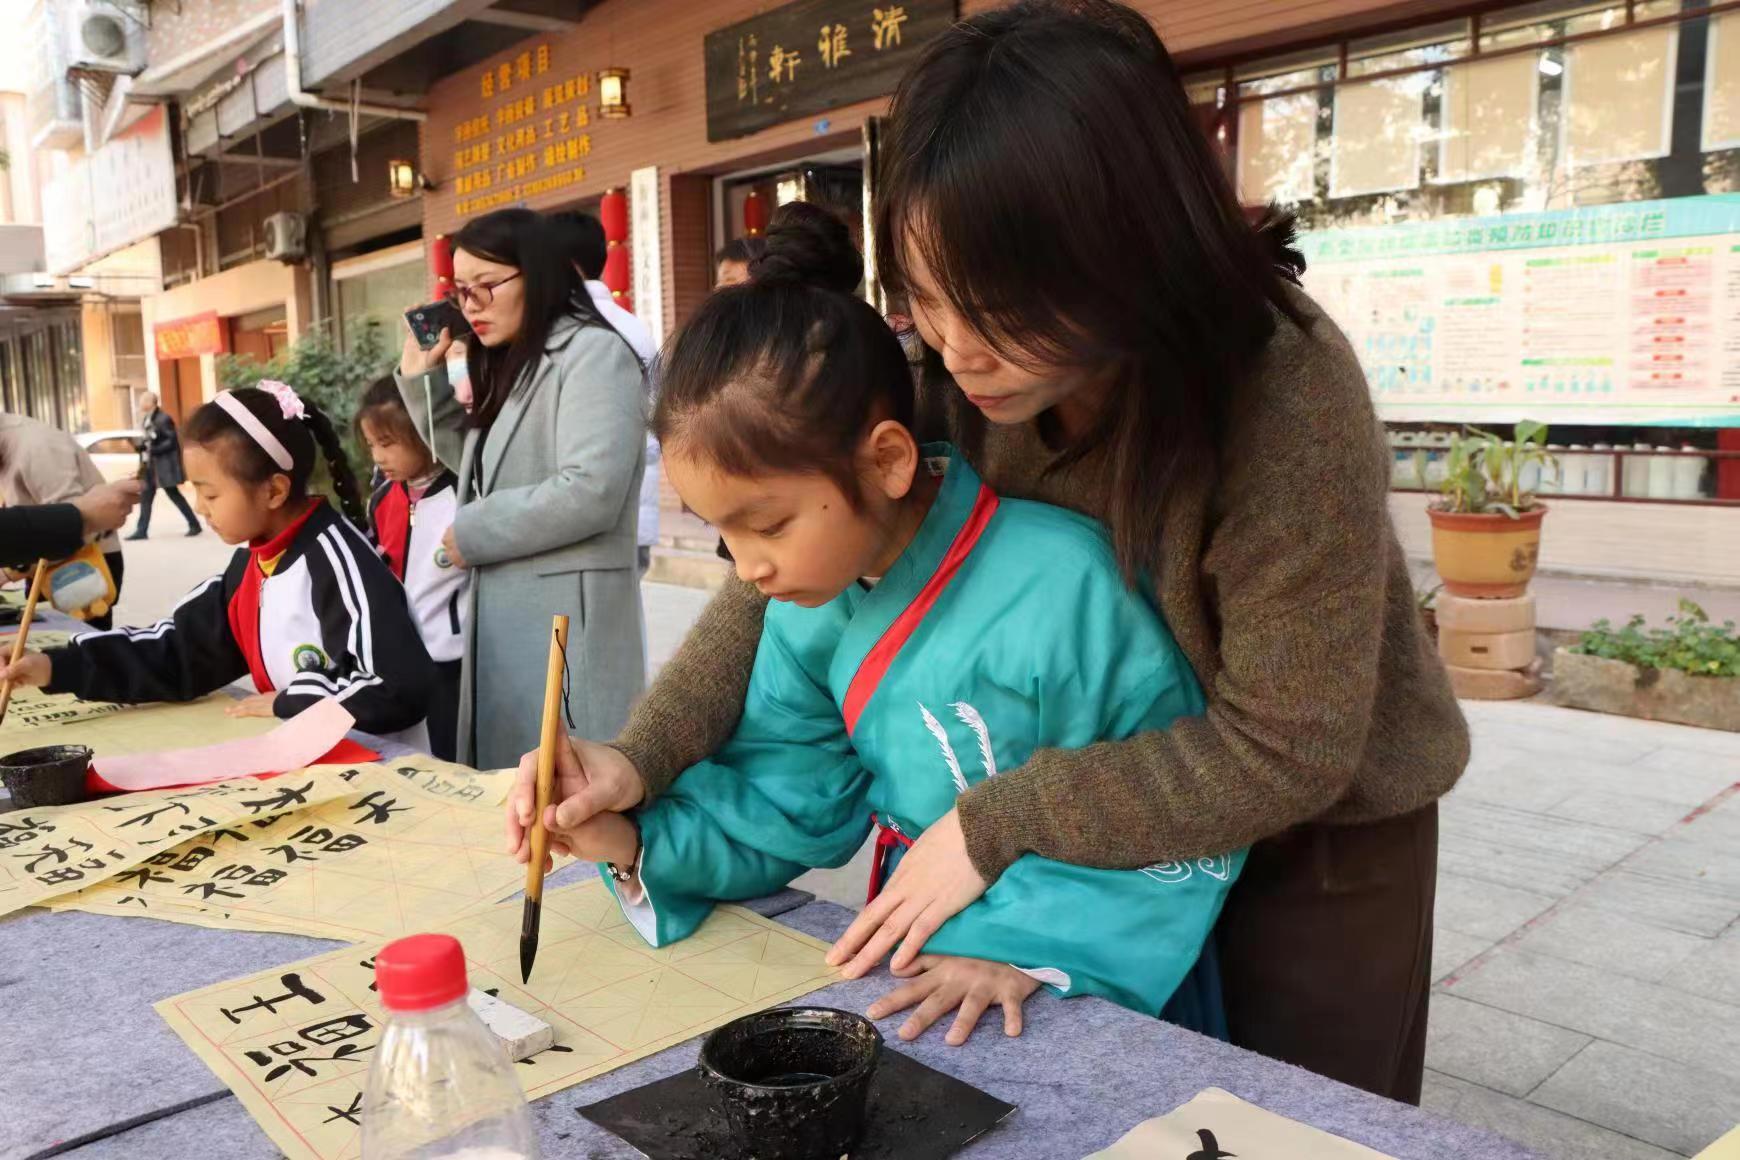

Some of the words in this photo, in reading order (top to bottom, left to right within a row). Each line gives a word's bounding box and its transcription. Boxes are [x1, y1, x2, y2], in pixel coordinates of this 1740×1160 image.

[481, 45, 549, 98] 经营项目
[497, 124, 537, 154] 文化用品
[544, 104, 589, 137] 工艺品
[497, 153, 536, 180] 广告制作
[260, 825, 369, 864] 福
[181, 864, 288, 900] 福
[244, 1014, 376, 1083] 福
